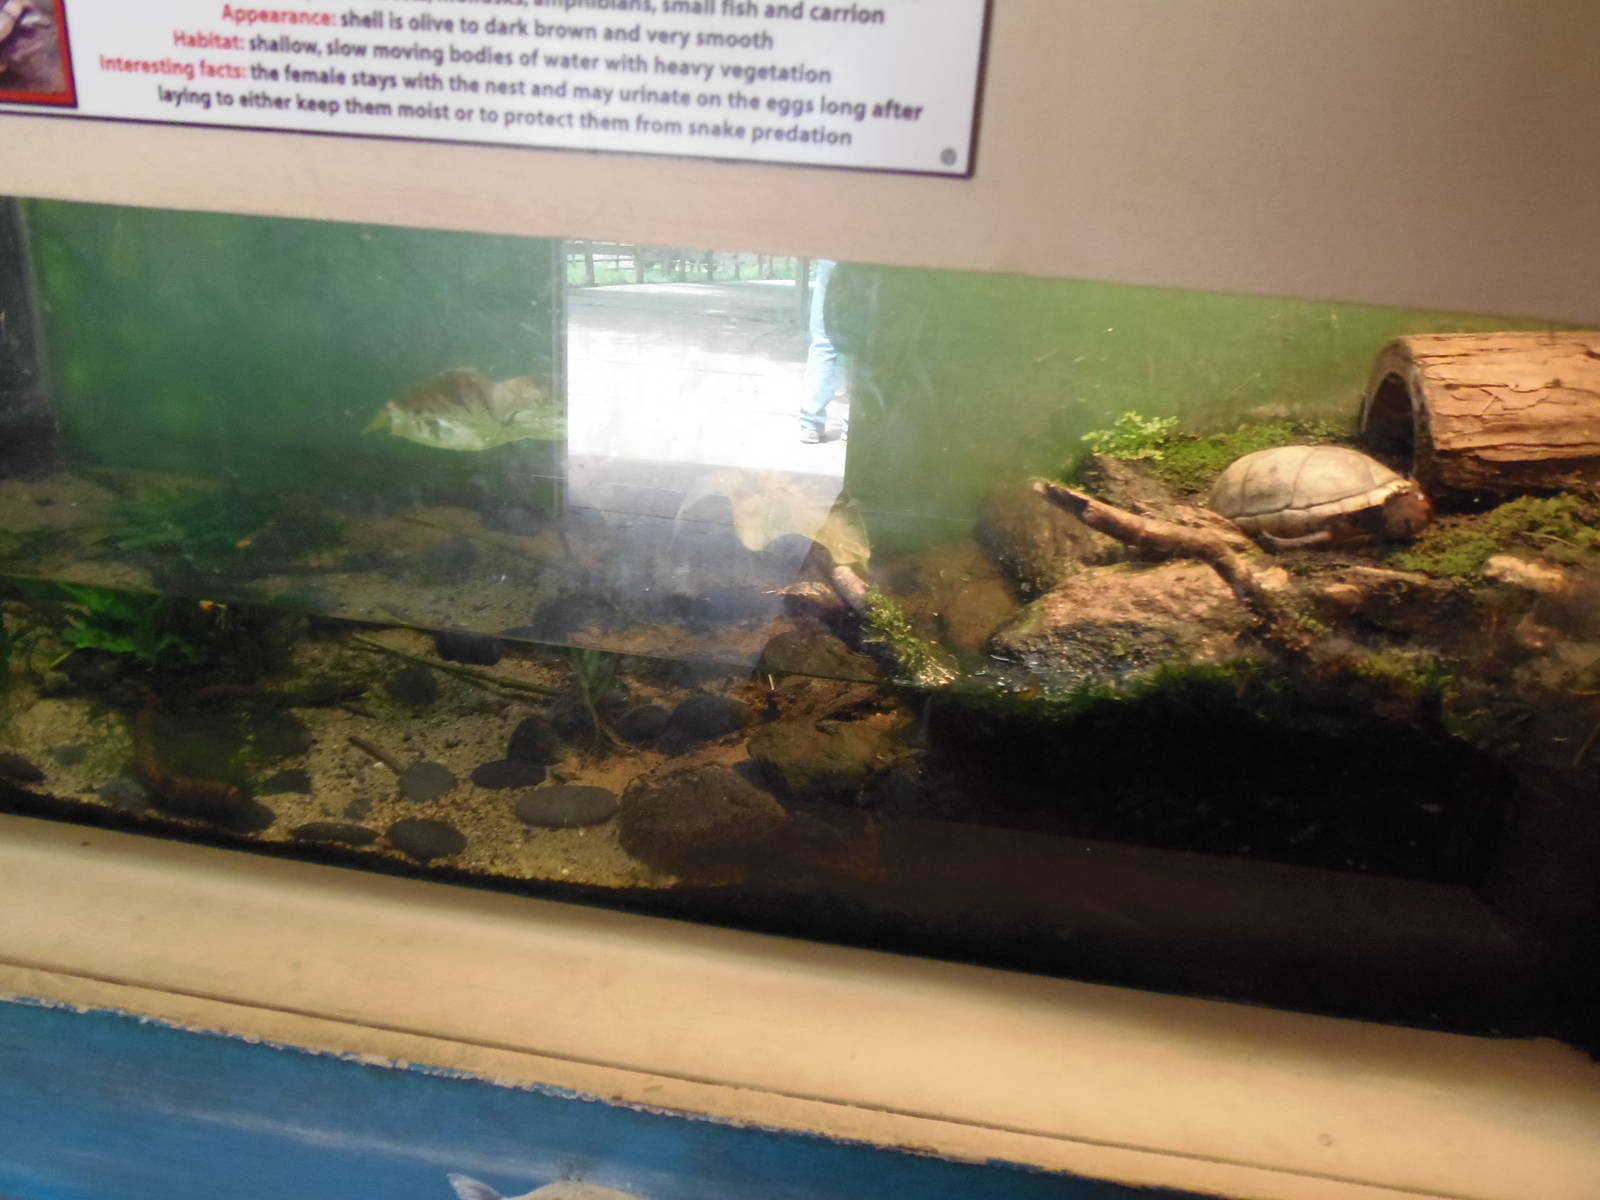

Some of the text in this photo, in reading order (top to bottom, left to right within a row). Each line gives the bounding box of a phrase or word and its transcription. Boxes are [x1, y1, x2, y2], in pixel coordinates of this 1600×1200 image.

[222, 4, 773, 49] Appearance: shell is olive to dark brown and very smooth
[662, 0, 715, 15] small
[721, 0, 758, 17] fish
[764, 1, 803, 20] and
[809, 4, 885, 24] carrion
[173, 30, 832, 84] Habitat: shallow, slow moving bodies of water with heavy vegetation
[99, 54, 923, 122] Interesting facts: the female stays with the nest and may urinate on the eggs long after
[158, 85, 852, 146] laying to either keep them moist or to protect them from snake predation
